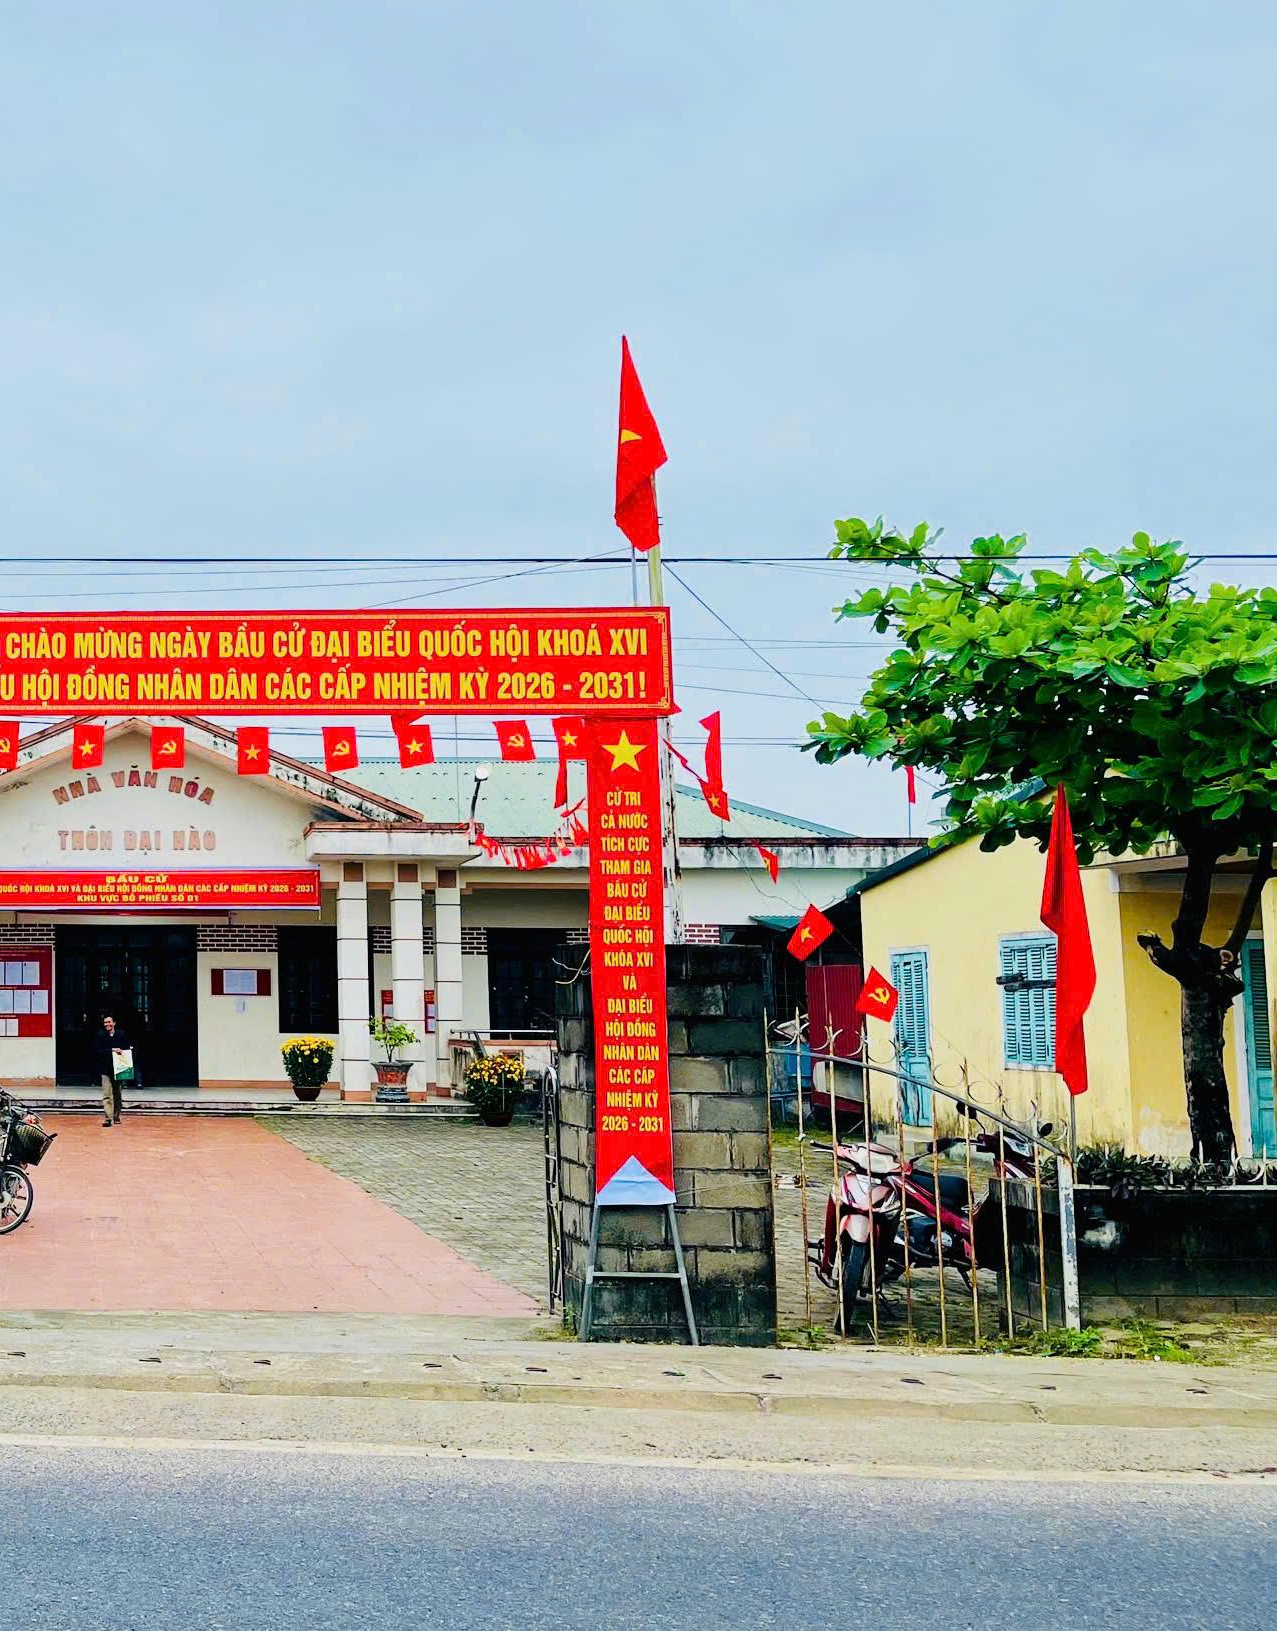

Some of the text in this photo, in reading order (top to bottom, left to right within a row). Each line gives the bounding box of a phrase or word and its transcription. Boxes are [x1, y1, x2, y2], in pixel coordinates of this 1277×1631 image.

[6, 626, 66, 660] CHÀO
[74, 626, 142, 659] MỪNG
[150, 625, 211, 659] NGÀY
[219, 622, 265, 658] BẦU
[273, 622, 306, 658] CỬ
[310, 629, 350, 663] ĐẠI
[358, 619, 411, 657] BIỂU
[419, 620, 482, 661] QUỐC
[490, 624, 530, 663] HỘI
[537, 623, 603, 657] KHOÁ
[610, 628, 647, 656] XVI
[23, 668, 59, 708] HỘI
[66, 664, 130, 700] ĐỒNG
[137, 668, 201, 699] NHÂN
[209, 668, 256, 699] DÂN
[265, 667, 312, 699] CÁC
[320, 663, 366, 699] CẤP
[374, 667, 451, 706] NHIỆM
[459, 666, 489, 699] KỲ
[497, 672, 555, 699] 2026
[579, 671, 646, 699] 2031!
[52, 765, 214, 805] NHÀ VĂN HÓA
[607, 786, 641, 806] CỬ TRI
[601, 810, 648, 829] CẢ NƯỚC
[600, 834, 650, 855] TÍCH CỰC
[600, 860, 652, 875] THAM GIA
[604, 900, 650, 923] ĐẠI BIỂU
[603, 925, 653, 947] QUỐC HỘI
[637, 952, 654, 967] XVI
[622, 973, 637, 990] VÀ
[607, 992, 653, 1016] ĐẠI BIỂU
[605, 1017, 656, 1040] HỘI ĐỒNG
[603, 1044, 659, 1061] NHÂN DÂN
[609, 1065, 655, 1084] CÁC CẤP
[607, 1089, 658, 1111] NHIỆM KỲ
[602, 1116, 628, 1131] 2026
[639, 1116, 663, 1132] 2031
